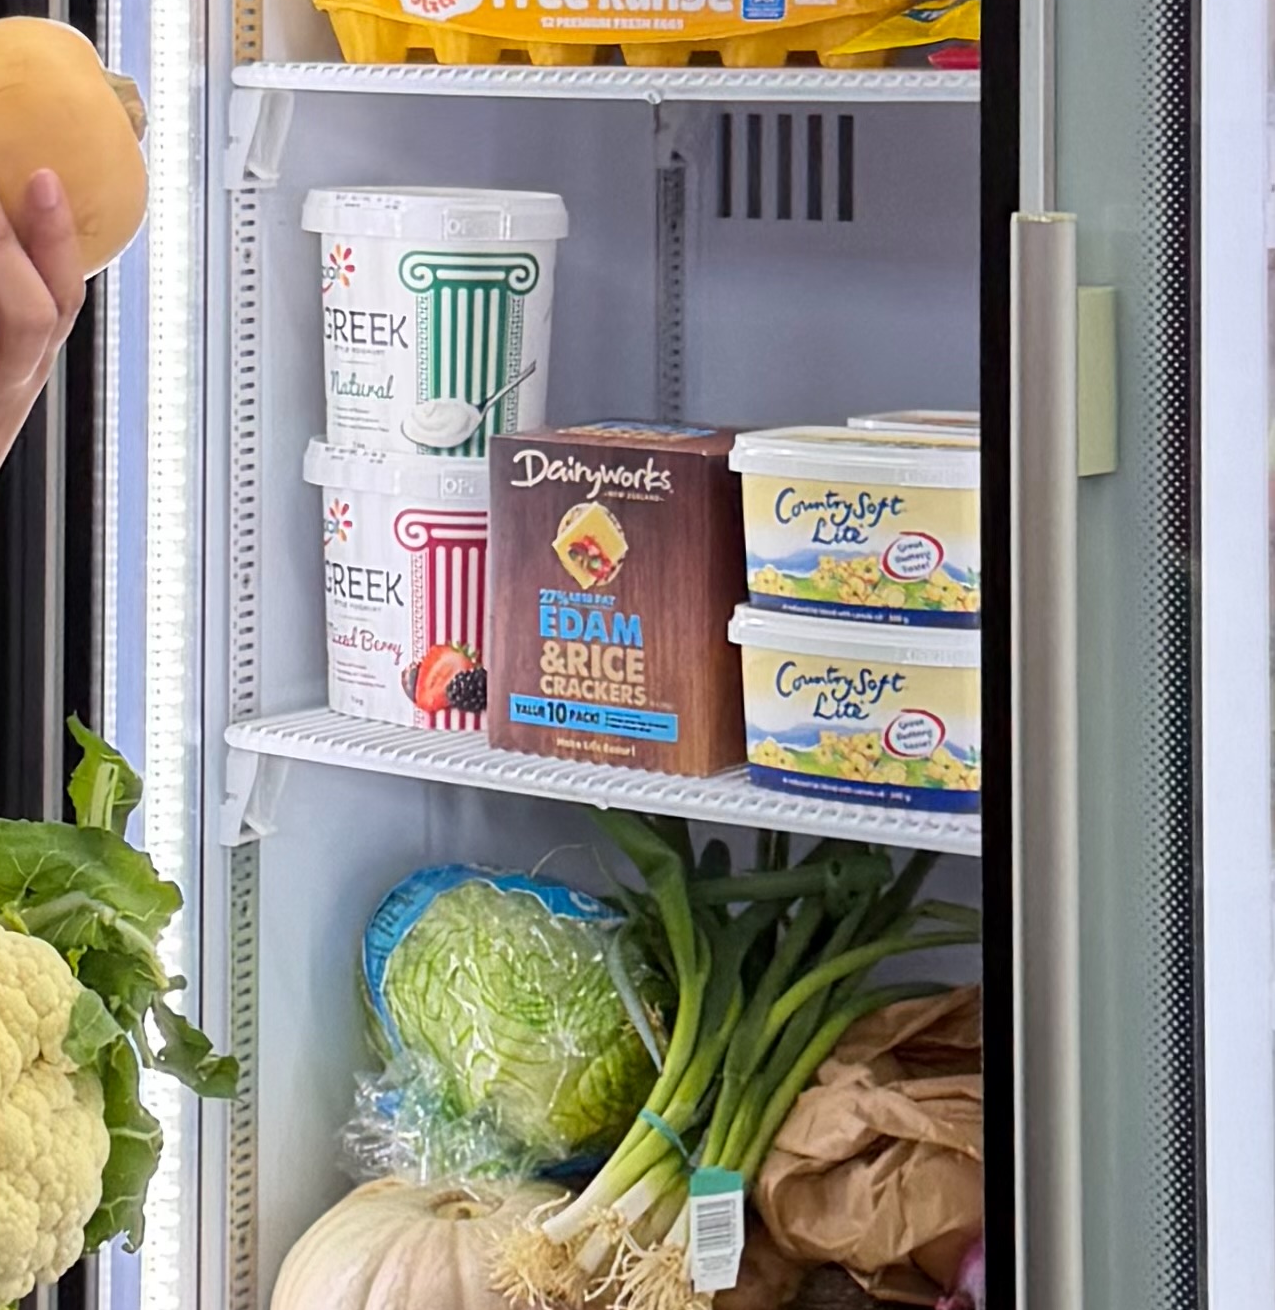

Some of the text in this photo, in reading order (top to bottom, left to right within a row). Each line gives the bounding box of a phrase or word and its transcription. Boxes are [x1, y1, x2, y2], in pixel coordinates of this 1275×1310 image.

[330, 370, 394, 400] Natural
[510, 449, 673, 500] Dairyworks
[812, 517, 868, 545] Lite
[539, 605, 644, 648] EDAM
[359, 629, 403, 666] Berry
[539, 675, 647, 706] CRACKERS
[813, 691, 869, 720] Lite
[547, 701, 567, 724] 10
